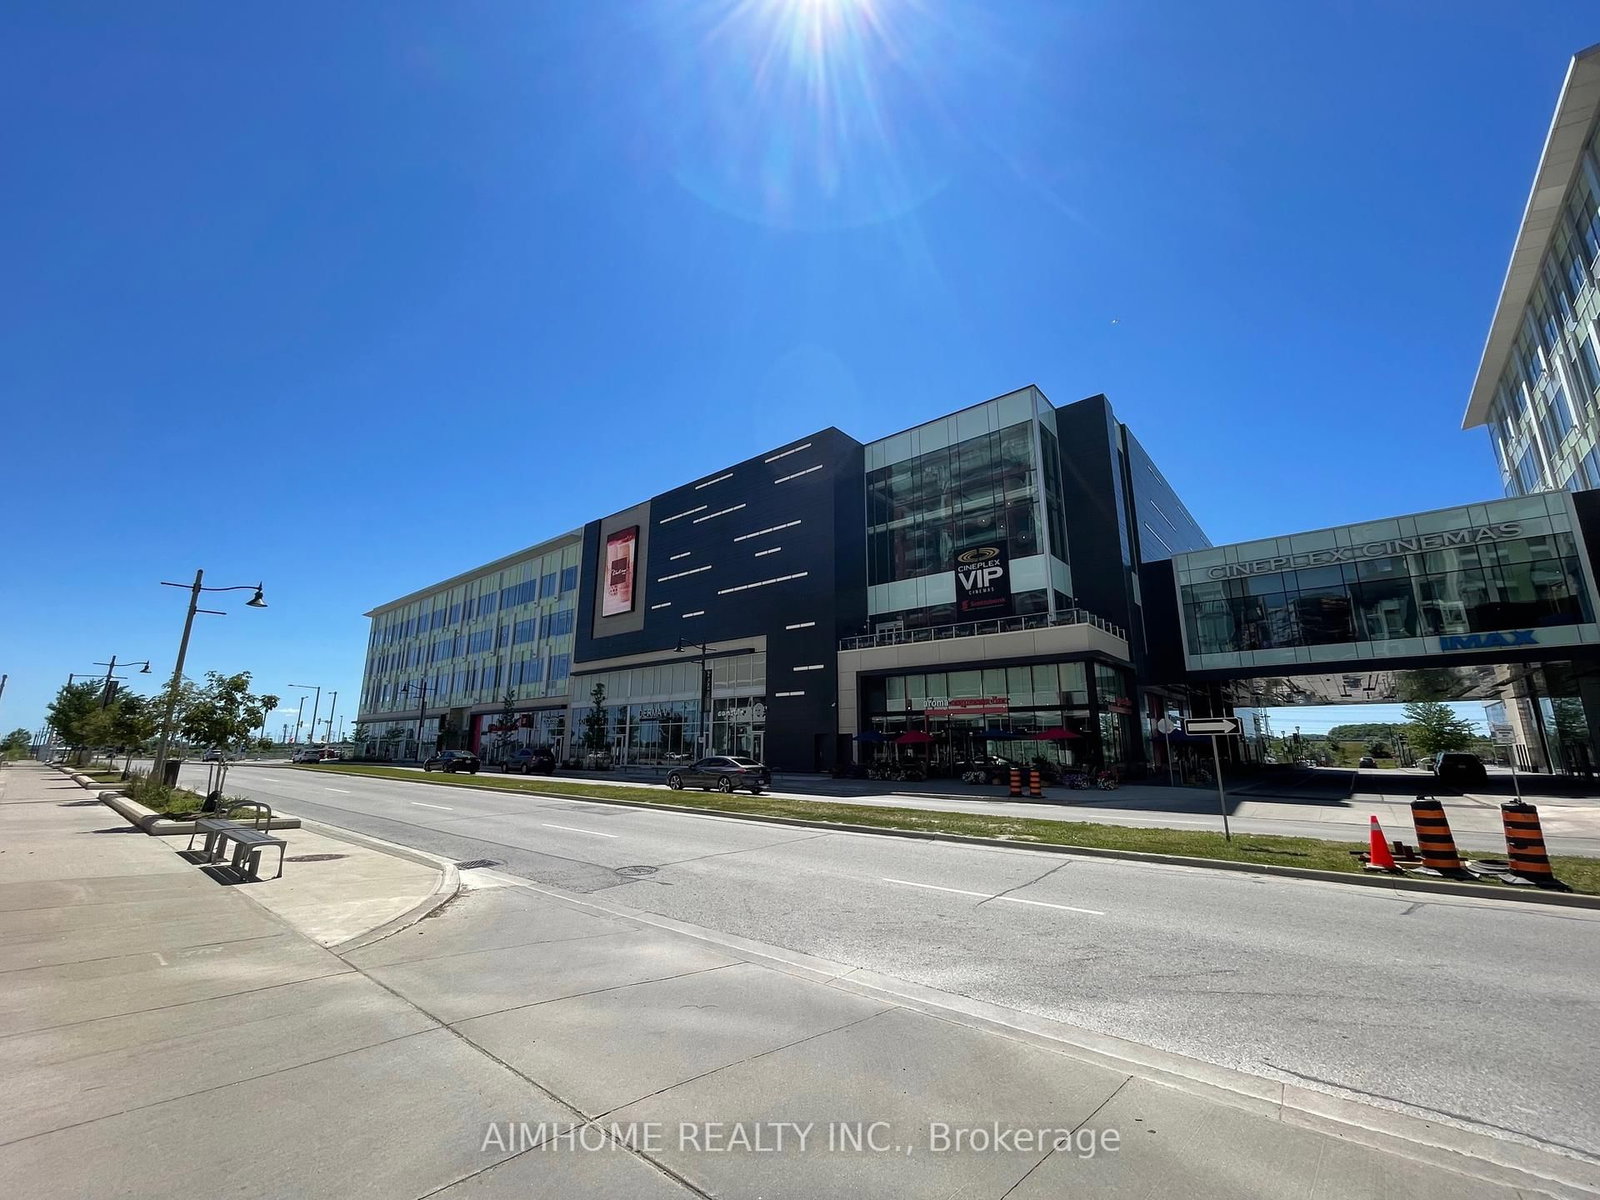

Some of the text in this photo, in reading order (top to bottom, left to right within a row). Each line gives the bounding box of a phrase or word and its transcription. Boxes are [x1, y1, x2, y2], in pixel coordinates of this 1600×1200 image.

[1208, 522, 1523, 580] CINEPLEX CINEMAS
[957, 559, 1001, 573] CINEPLEX
[958, 566, 1003, 590] VIP
[1439, 629, 1540, 651] IMAX
